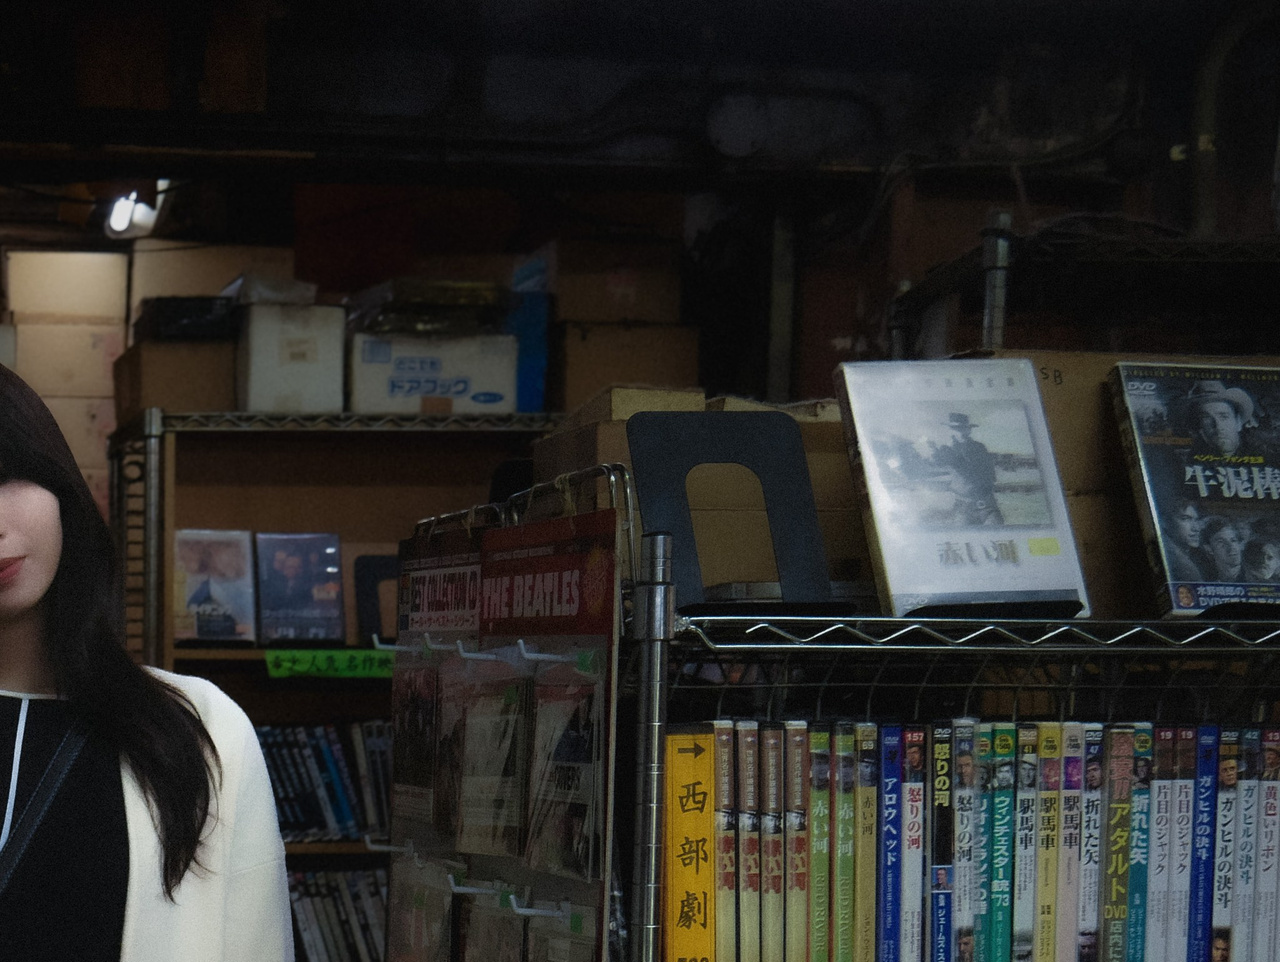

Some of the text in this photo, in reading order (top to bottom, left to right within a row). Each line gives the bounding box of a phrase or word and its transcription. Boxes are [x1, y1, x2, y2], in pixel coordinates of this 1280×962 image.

[483, 576, 510, 620] THE
[512, 569, 580, 618] BEATLES
[933, 743, 951, 808] 怒りの河
[810, 797, 829, 855] 赤い河
[838, 802, 855, 857] 赤い河
[883, 777, 899, 866] アロウヘッド
[906, 786, 922, 851] 怒りの河
[956, 795, 973, 863] 怒りの河
[1018, 797, 1035, 851] 駅馬車
[1039, 797, 1057, 850] 駅馬車
[1063, 794, 1080, 849] 駅馬車
[1083, 798, 1101, 866] 折れた矢
[1107, 802, 1130, 902] アダルト
[1129, 794, 1149, 866] 折れた矢
[1154, 785, 1171, 876] 片目のジャック
[1176, 785, 1192, 875] 片目のジャック
[1196, 775, 1213, 861] ガンヒルの決斗
[1239, 785, 1258, 886] ガンヒルの決斗
[1260, 785, 1279, 873] 黄色いリボン
[676, 780, 709, 930] 西部劇
[1216, 797, 1235, 909] ガンヒルの決斗
[1104, 904, 1128, 919] DVD
